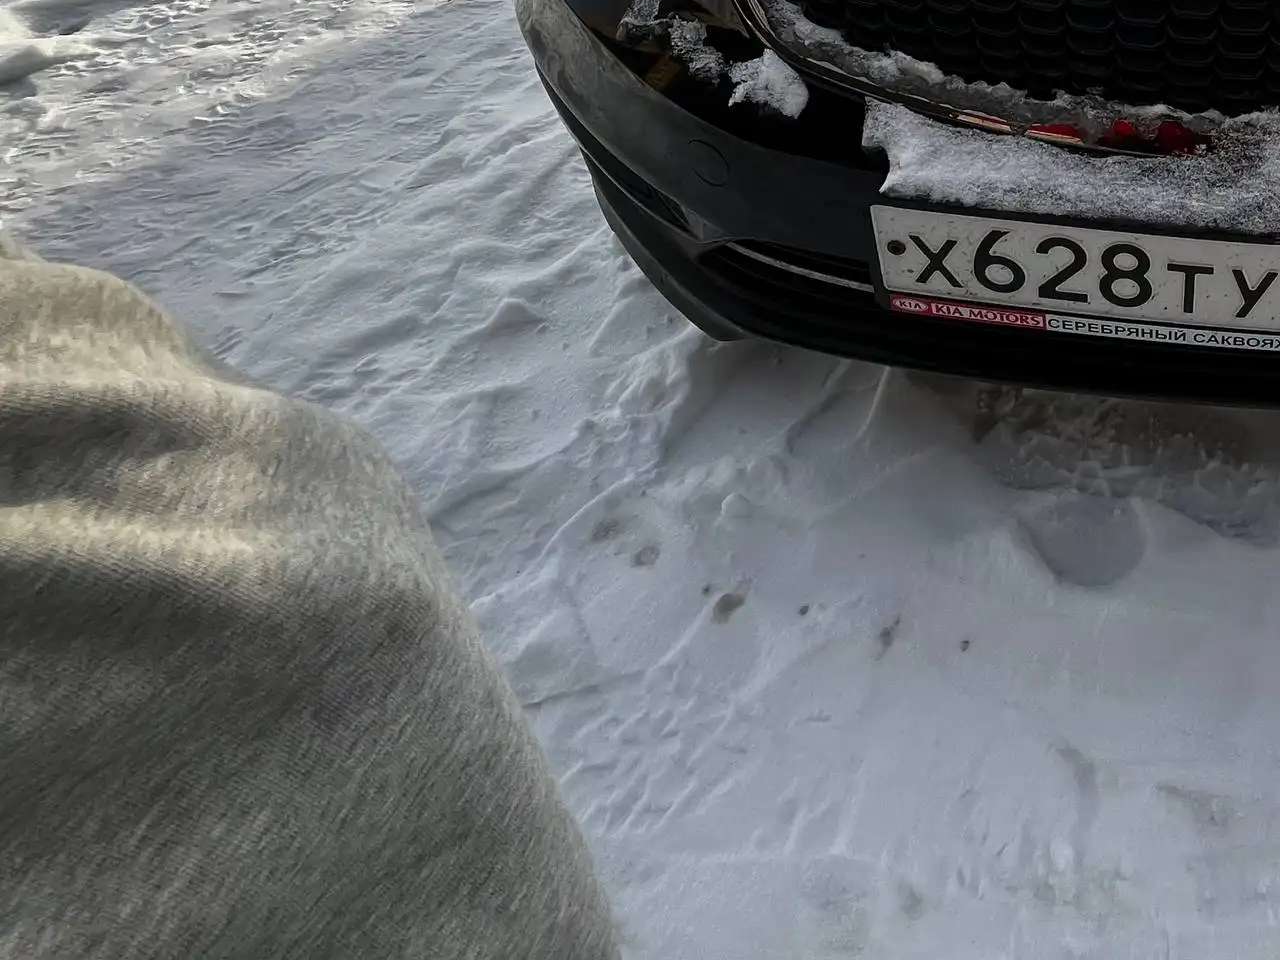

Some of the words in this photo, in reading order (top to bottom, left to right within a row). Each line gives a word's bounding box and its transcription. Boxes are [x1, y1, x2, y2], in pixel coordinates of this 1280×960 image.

[908, 229, 1279, 318] Х628ТУ
[898, 299, 922, 310] KIA
[934, 303, 964, 318] KIA
[968, 307, 1042, 327] MOTORS
[1047, 317, 1187, 342] СЕРЕБРЯНЫЙ
